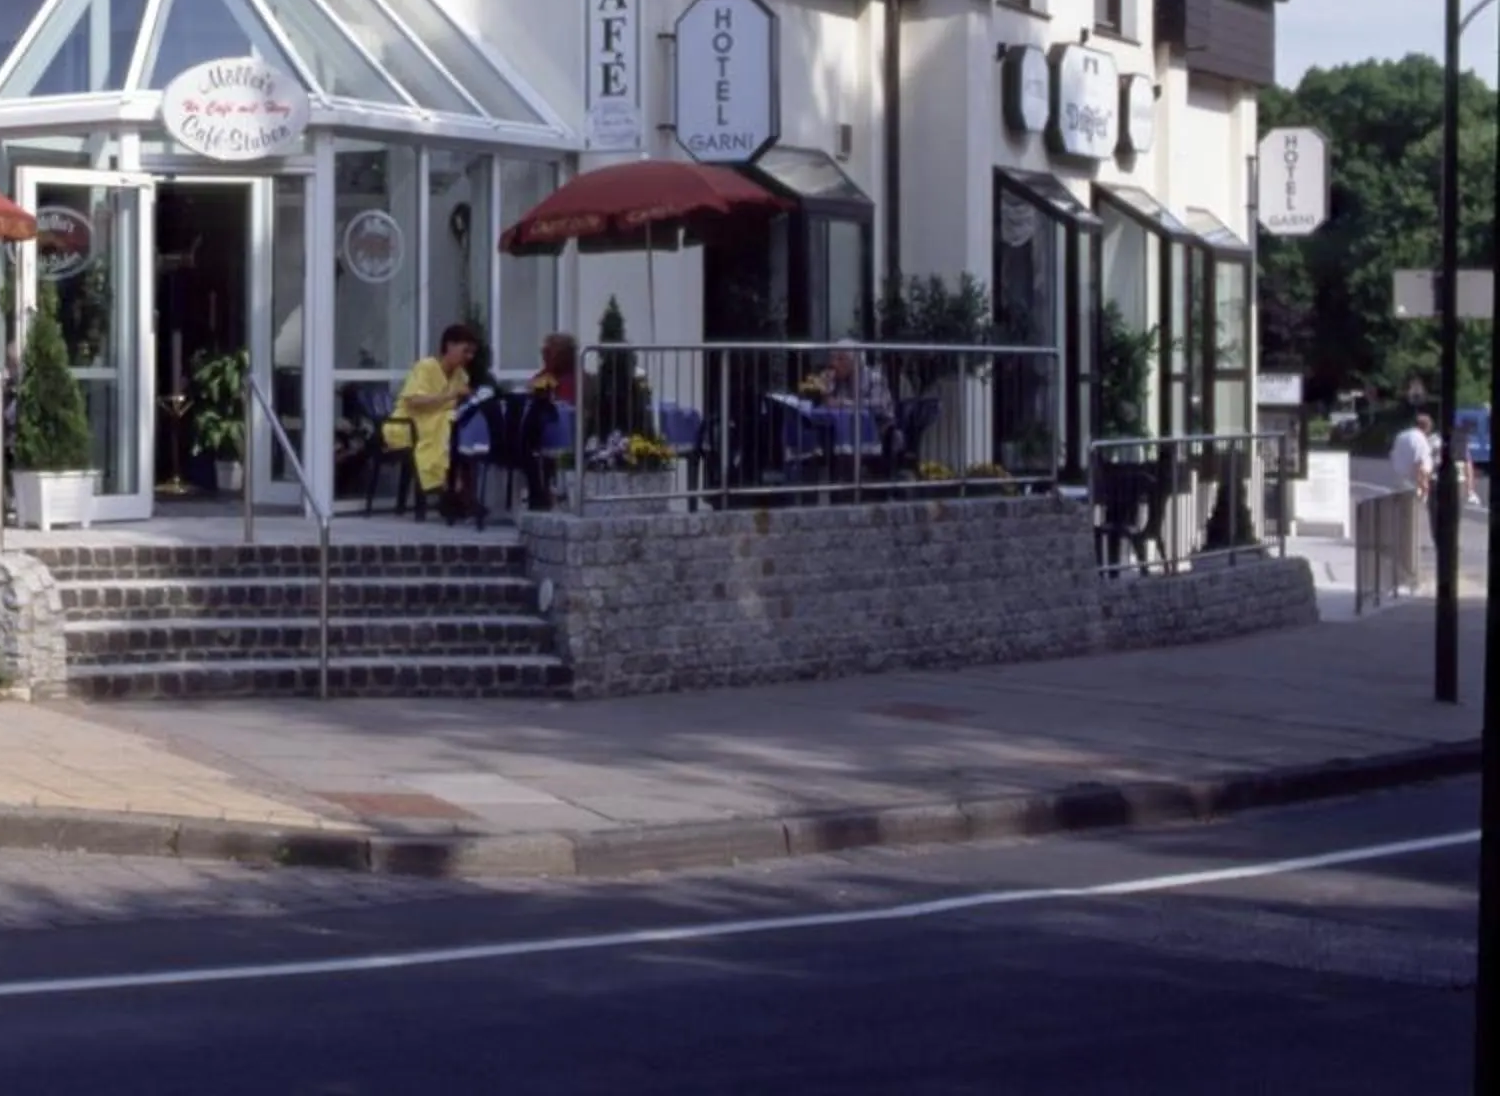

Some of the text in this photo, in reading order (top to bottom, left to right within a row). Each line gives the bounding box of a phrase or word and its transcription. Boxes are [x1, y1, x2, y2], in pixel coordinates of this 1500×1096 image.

[711, 7, 734, 127] HOTEL
[689, 133, 754, 152] GARNI
[1283, 135, 1299, 212] HOTEL
[1268, 215, 1315, 227] GARNI
